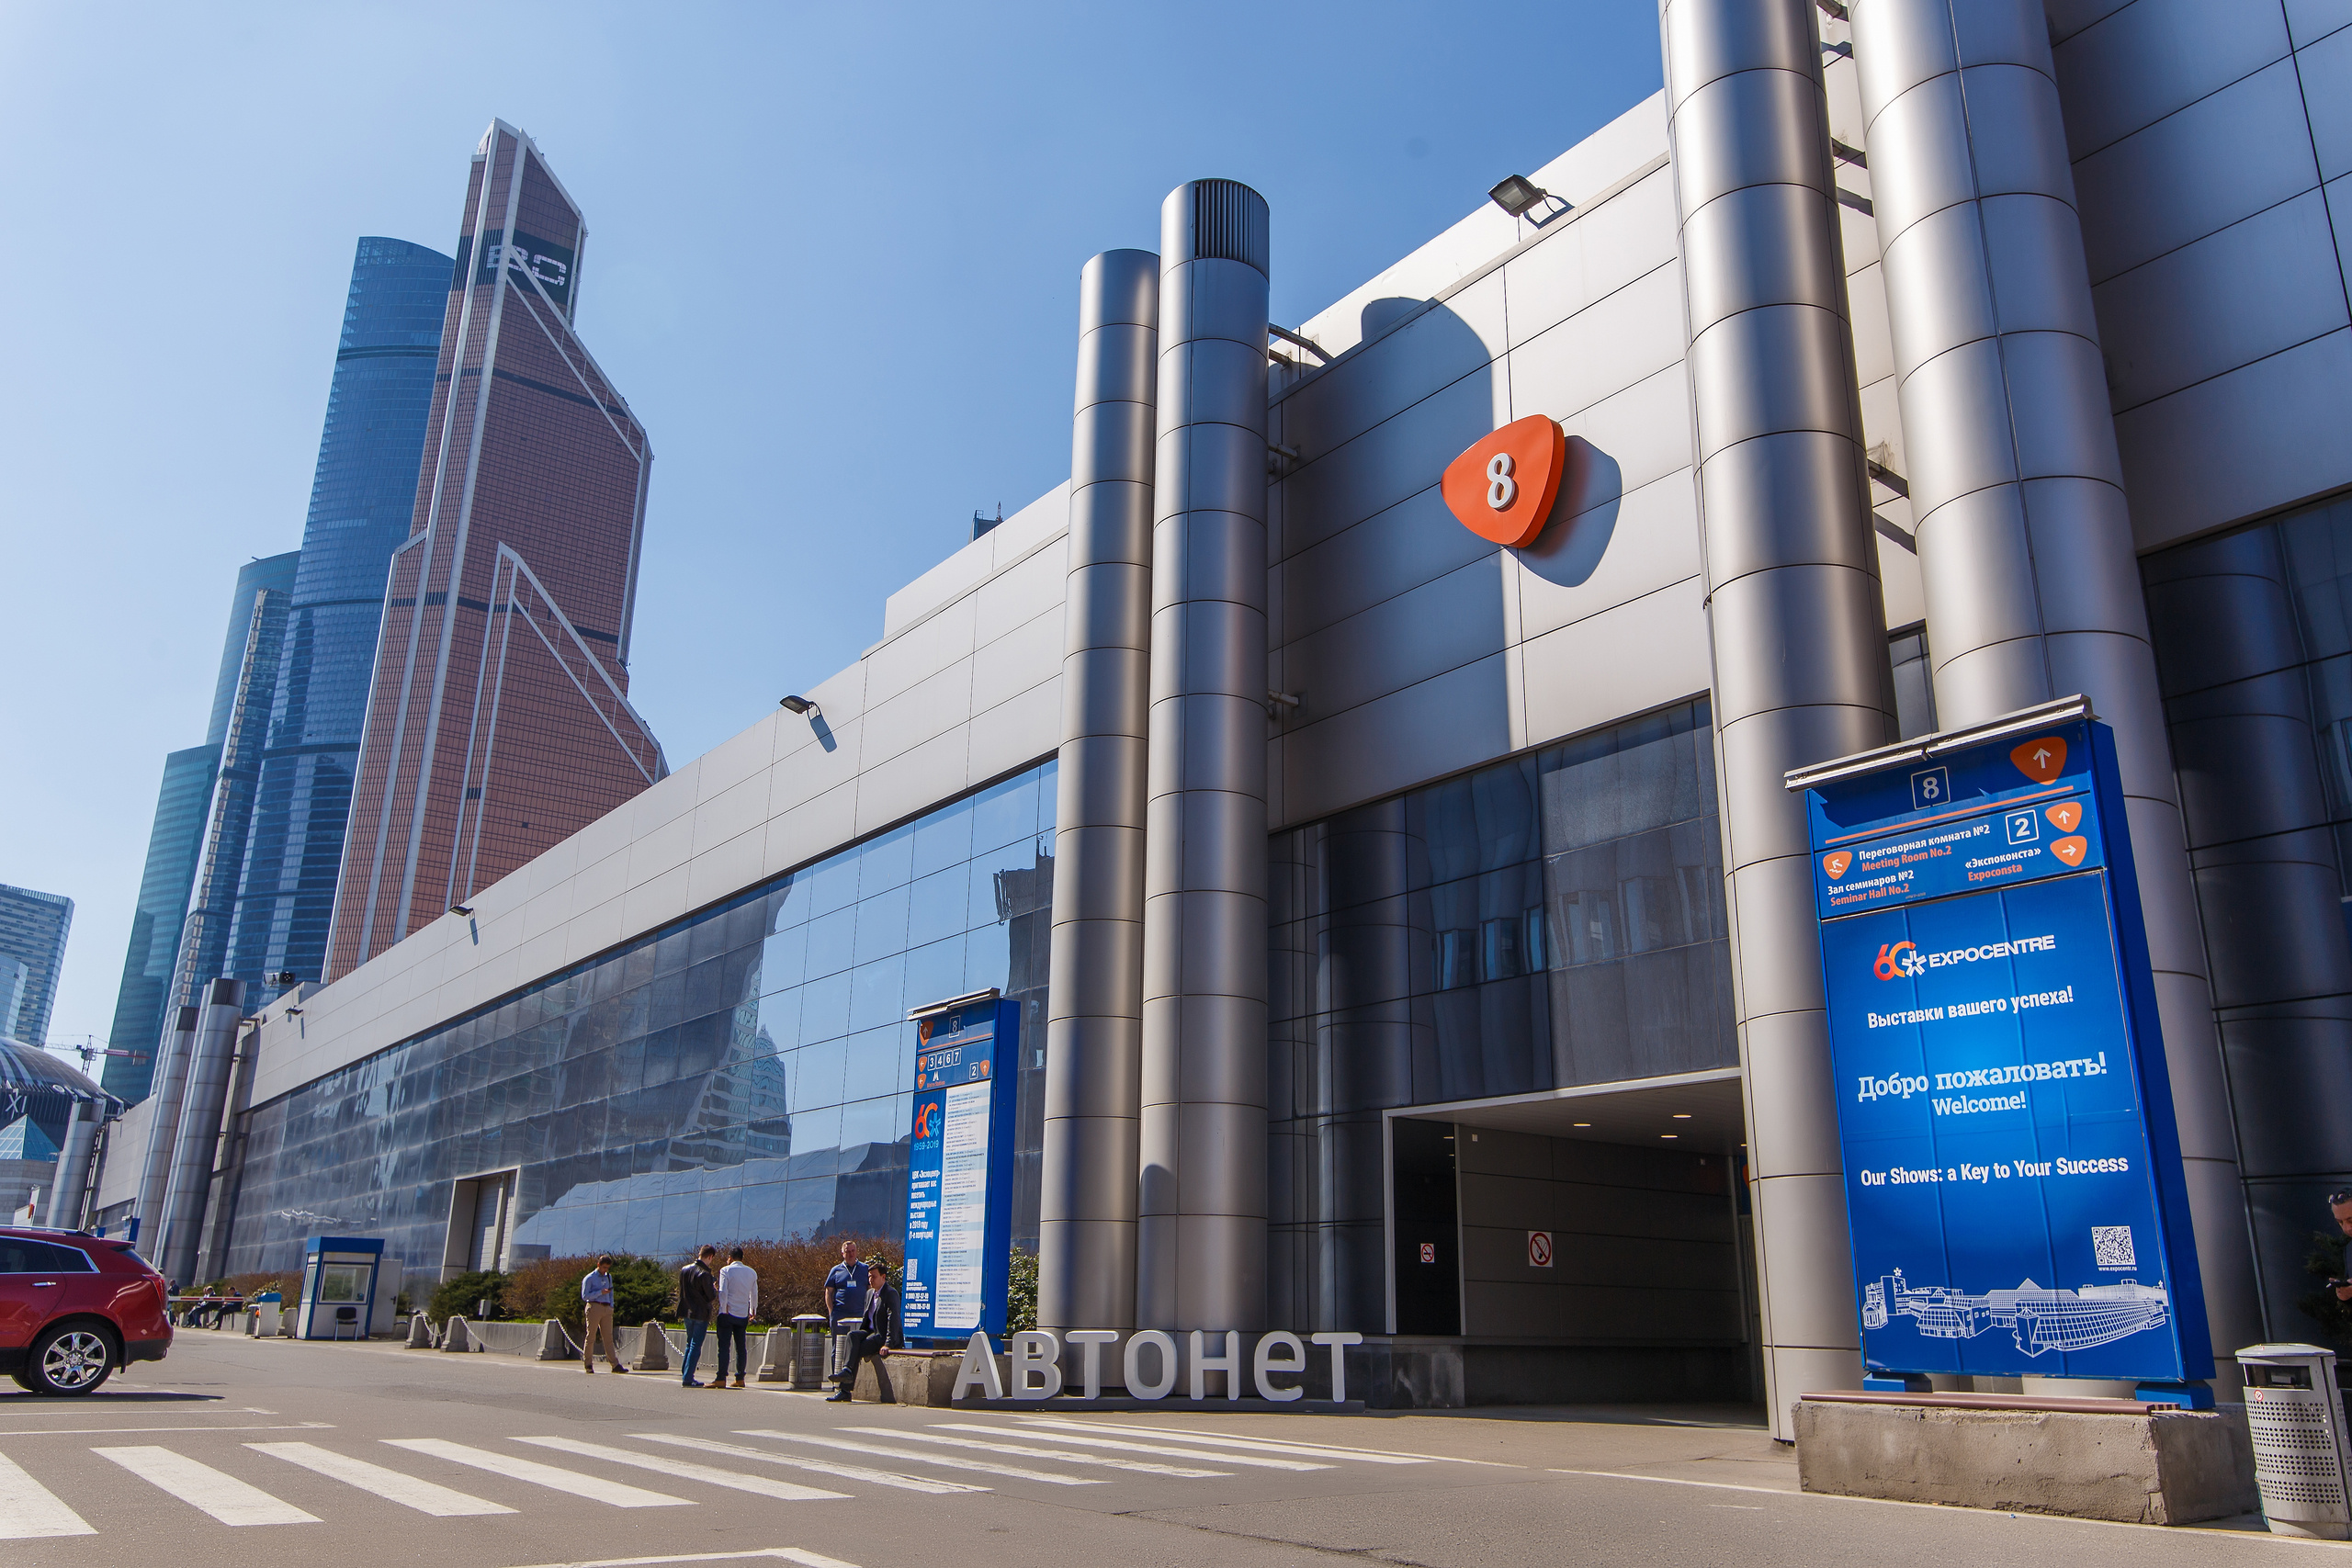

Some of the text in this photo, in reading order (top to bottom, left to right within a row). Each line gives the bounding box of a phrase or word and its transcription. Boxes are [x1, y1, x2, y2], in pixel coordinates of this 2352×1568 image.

[1487, 452, 1515, 510] 8
[1923, 776, 1939, 800] 8
[2014, 818, 2030, 838] 2
[1859, 824, 1991, 861] Переговорная комната №2
[1861, 845, 1952, 873] Meeting Room No.2
[1964, 847, 2041, 870] «Экспоконста»
[1827, 869, 1915, 896] Зал семинаров №2
[1968, 863, 2023, 882] Expoconsta
[1830, 890, 1866, 907] Seminar
[1869, 886, 1887, 900] Hall
[1888, 883, 1910, 897] No.2
[1929, 934, 2056, 968] EXPOCENTRE
[1867, 986, 2074, 1029] Выставки вашего успеха!
[1857, 1052, 2108, 1102] Добро пожаловать!
[1931, 1090, 2027, 1117] Welcome!
[913, 1139, 939, 1151] 1959-2019
[1860, 1156, 2130, 1187] Our Shows: a Key to Your Success
